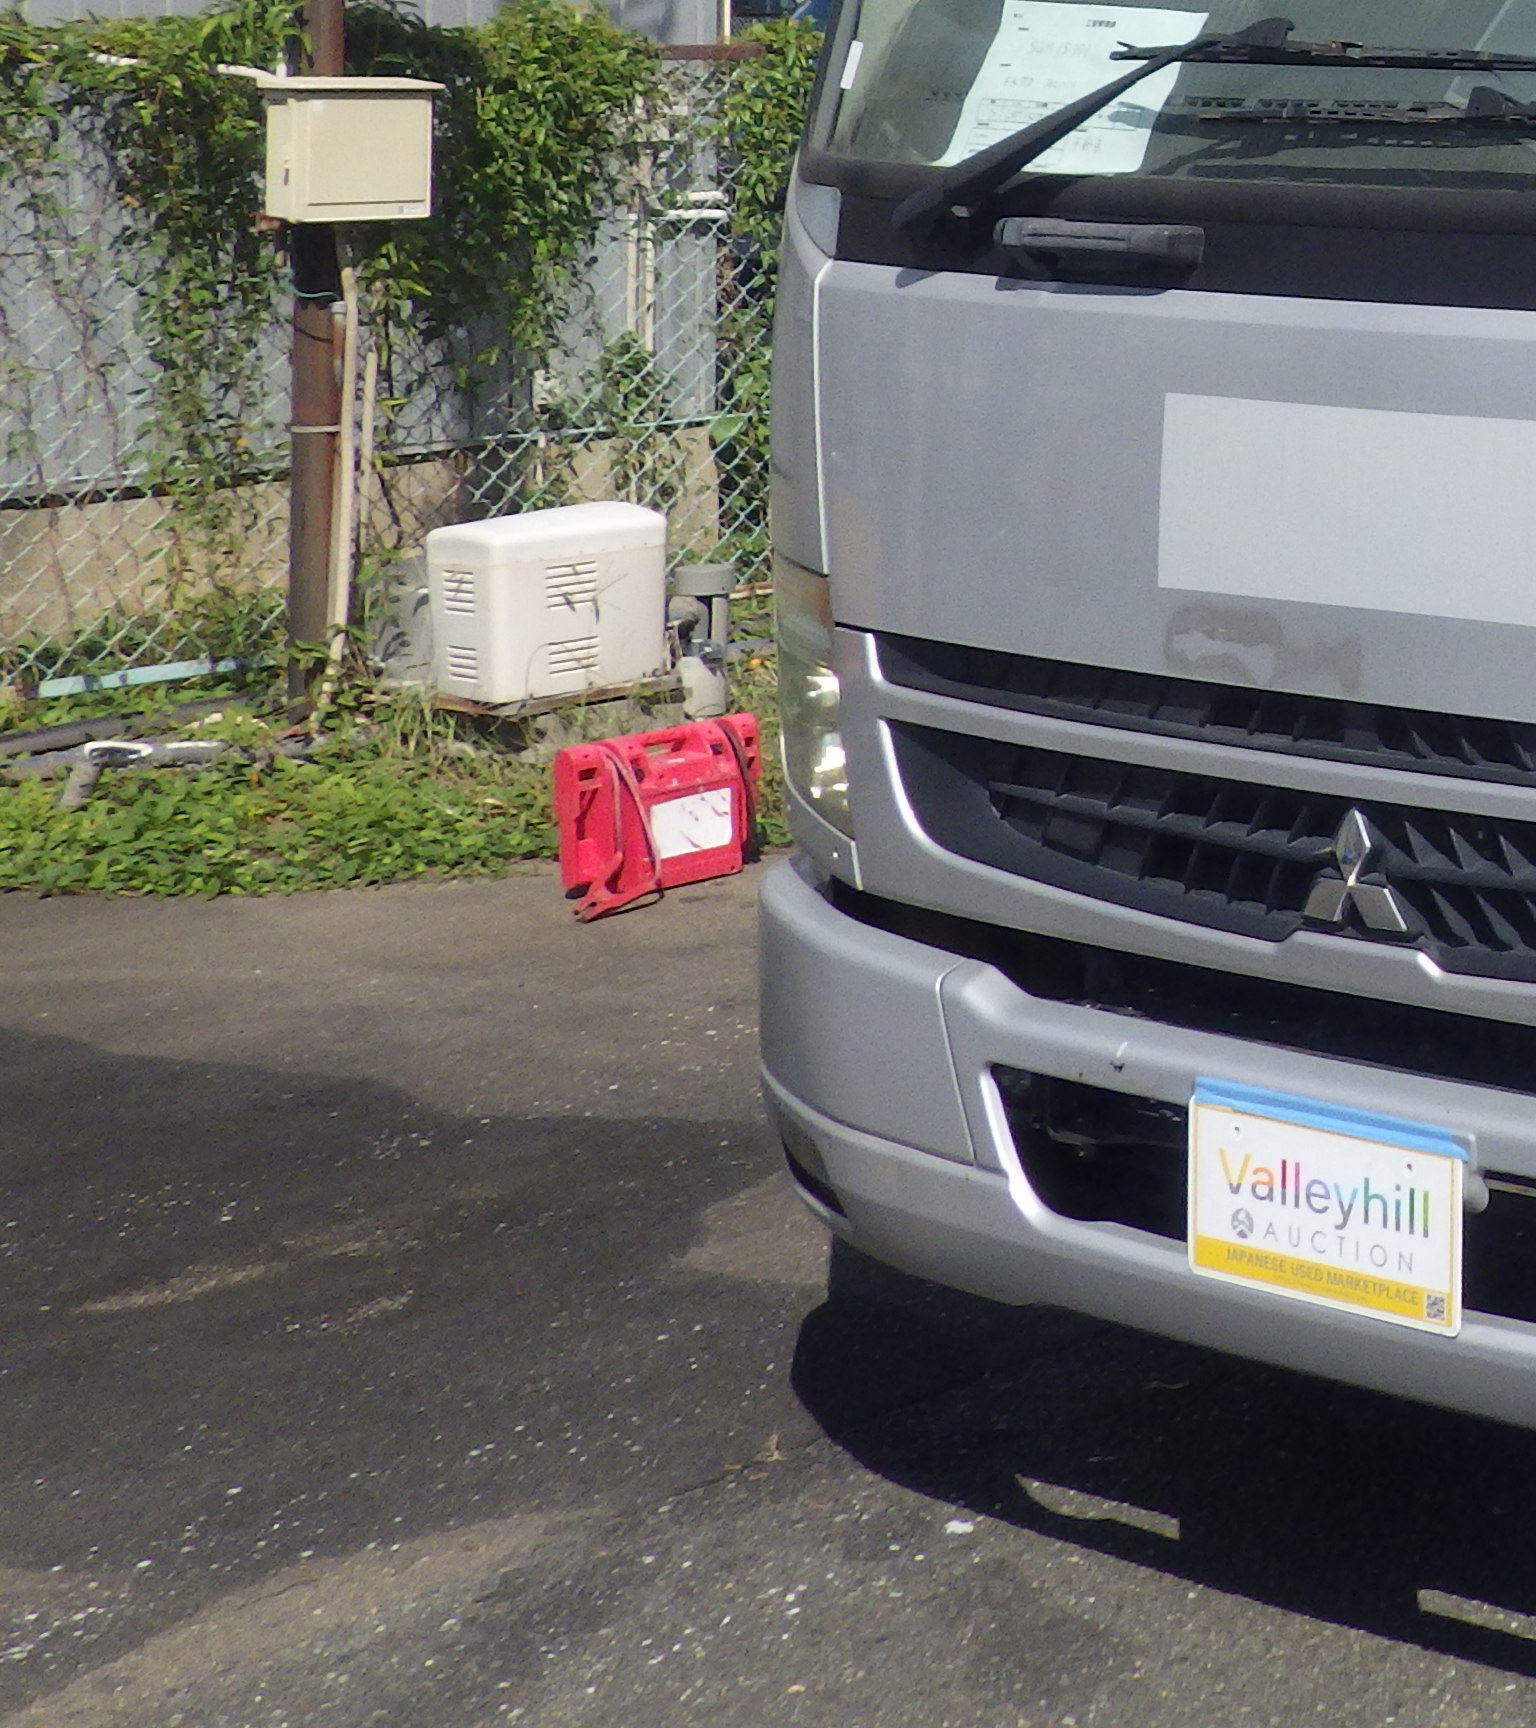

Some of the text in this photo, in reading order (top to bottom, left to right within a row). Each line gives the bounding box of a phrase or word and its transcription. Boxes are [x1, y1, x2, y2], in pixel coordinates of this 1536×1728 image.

[1218, 1147, 1430, 1239] Valleyhill
[1225, 1247, 1287, 1274] JAPANESE
[1290, 1262, 1324, 1283] USED
[1326, 1270, 1419, 1306] MARKETPLACE
[1263, 1221, 1414, 1273] AUCTION
